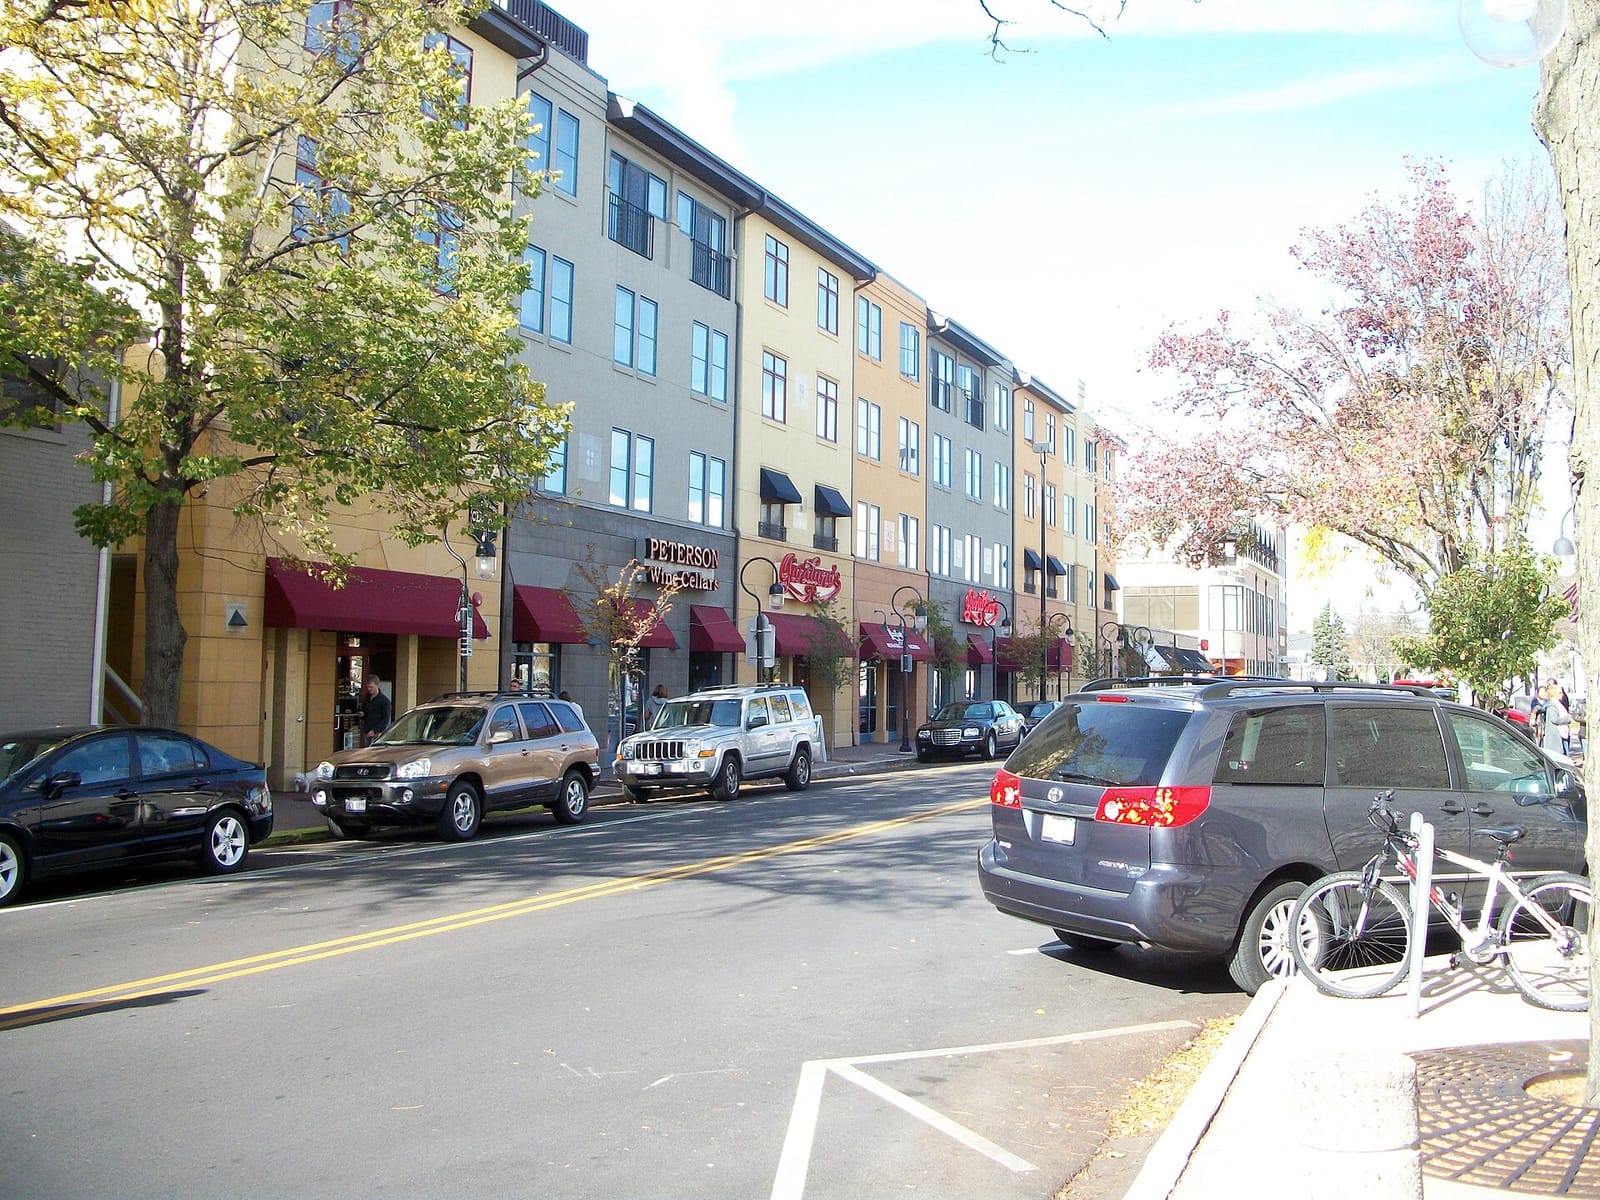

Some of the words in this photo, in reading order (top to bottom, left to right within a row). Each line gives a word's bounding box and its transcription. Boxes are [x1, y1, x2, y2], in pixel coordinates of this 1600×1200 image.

[650, 538, 719, 569] PETERSON
[650, 566, 679, 586] Wine
[681, 571, 719, 591] Cellars
